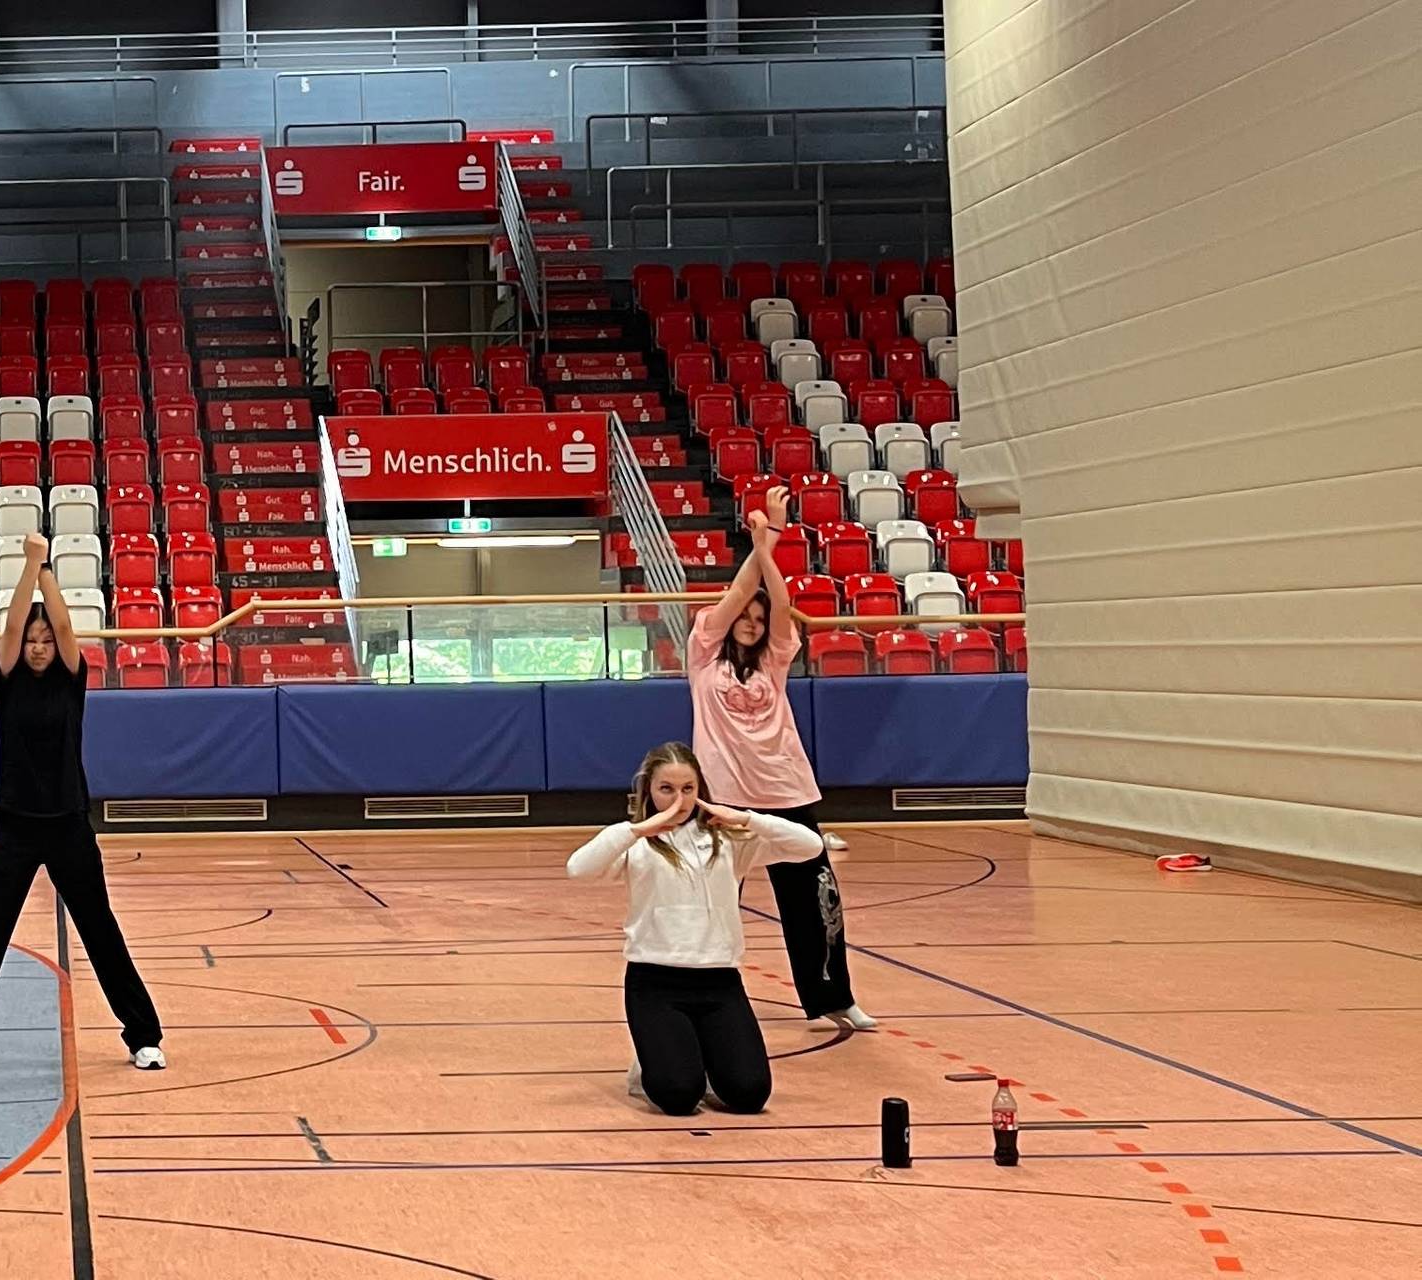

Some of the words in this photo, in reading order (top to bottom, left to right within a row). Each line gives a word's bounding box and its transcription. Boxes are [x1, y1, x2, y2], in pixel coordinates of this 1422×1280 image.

[358, 170, 406, 192] Fair.
[383, 446, 553, 475] Menschlich.
[272, 545, 293, 554] Nah.
[258, 561, 311, 571] Menschlich.
[231, 575, 249, 587] 45
[284, 614, 304, 624] Fair.
